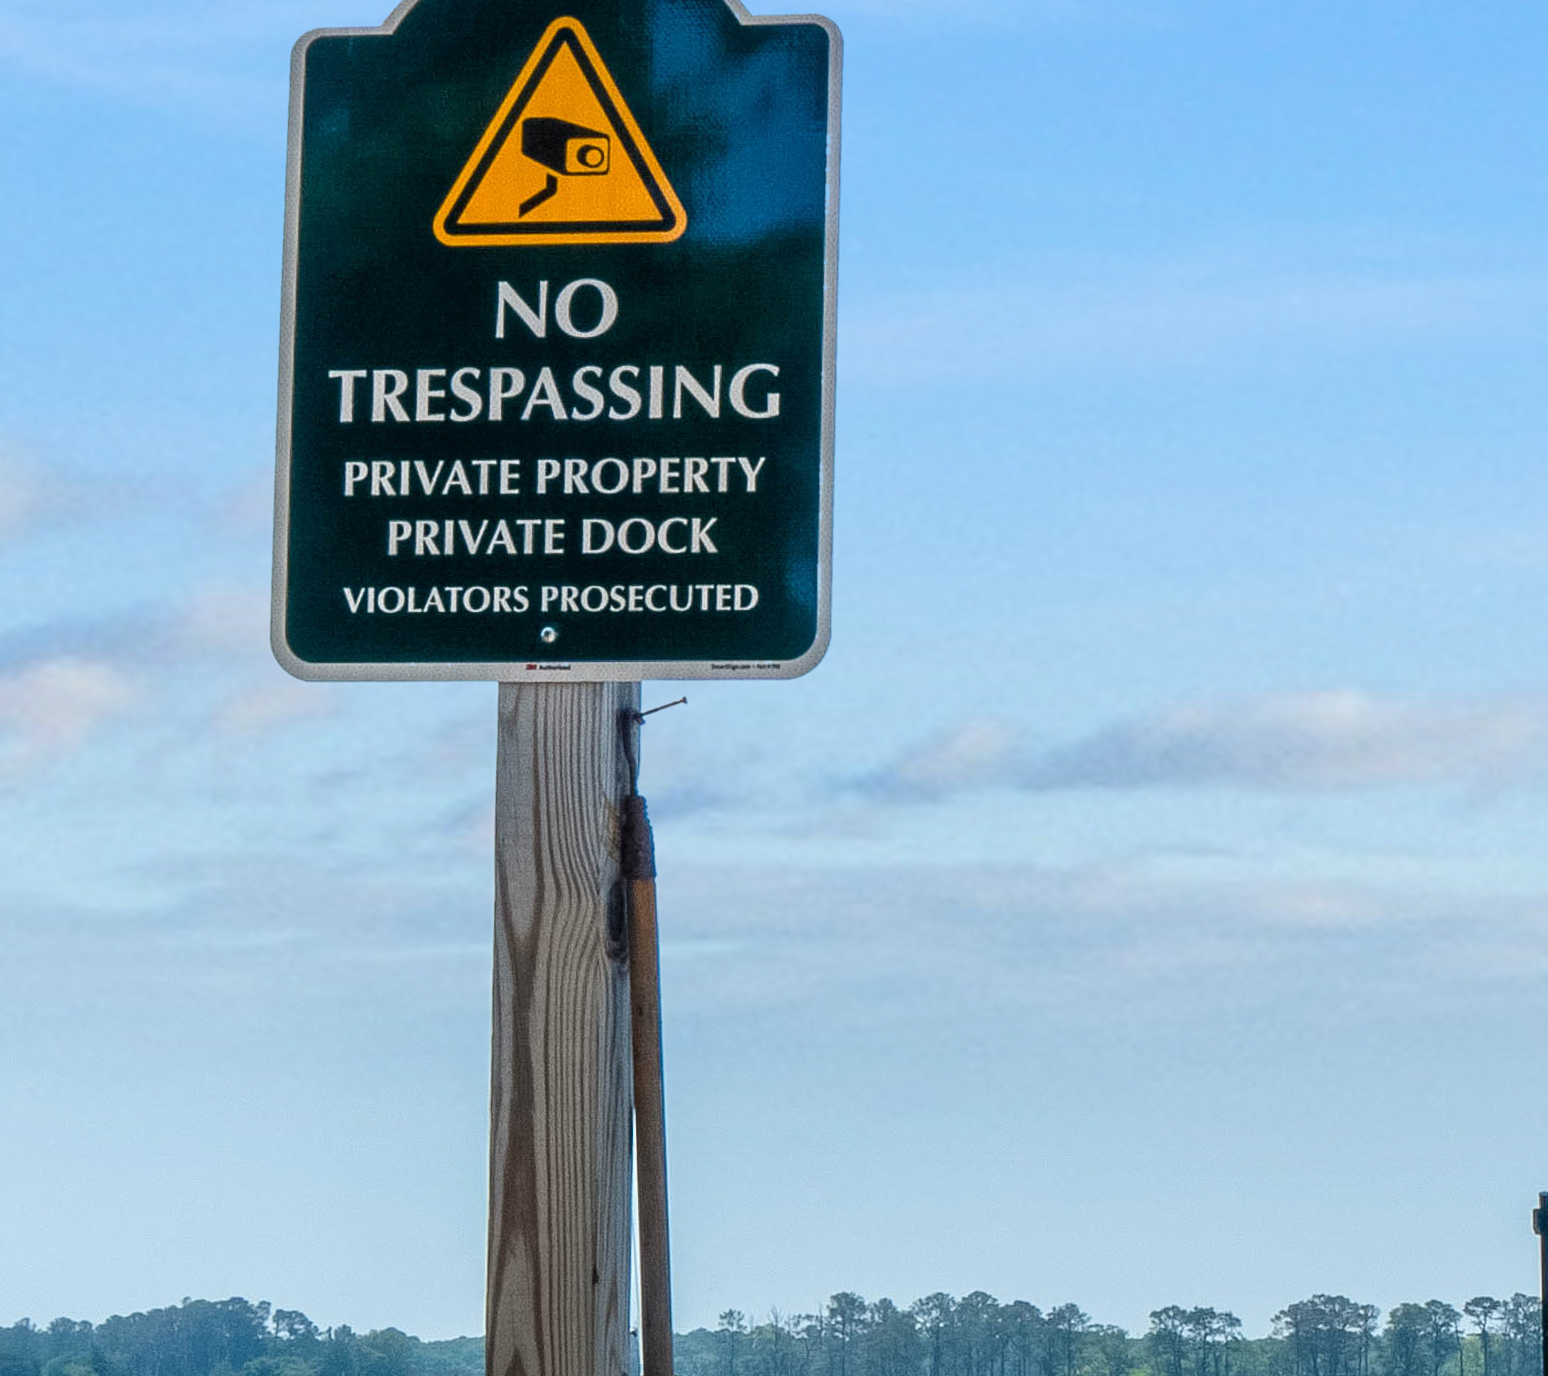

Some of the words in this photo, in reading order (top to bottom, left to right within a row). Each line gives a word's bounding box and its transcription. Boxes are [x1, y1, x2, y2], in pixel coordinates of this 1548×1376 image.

[494, 277, 620, 340] NO
[328, 363, 782, 424] TRESPASSING
[343, 459, 521, 498] PRIVATE
[535, 456, 767, 496] PROPERTY
[387, 519, 565, 557] PRIVATE
[580, 517, 719, 555] DOCK
[342, 585, 530, 615] VIOLATORS
[540, 583, 760, 613] PROSECUTED
